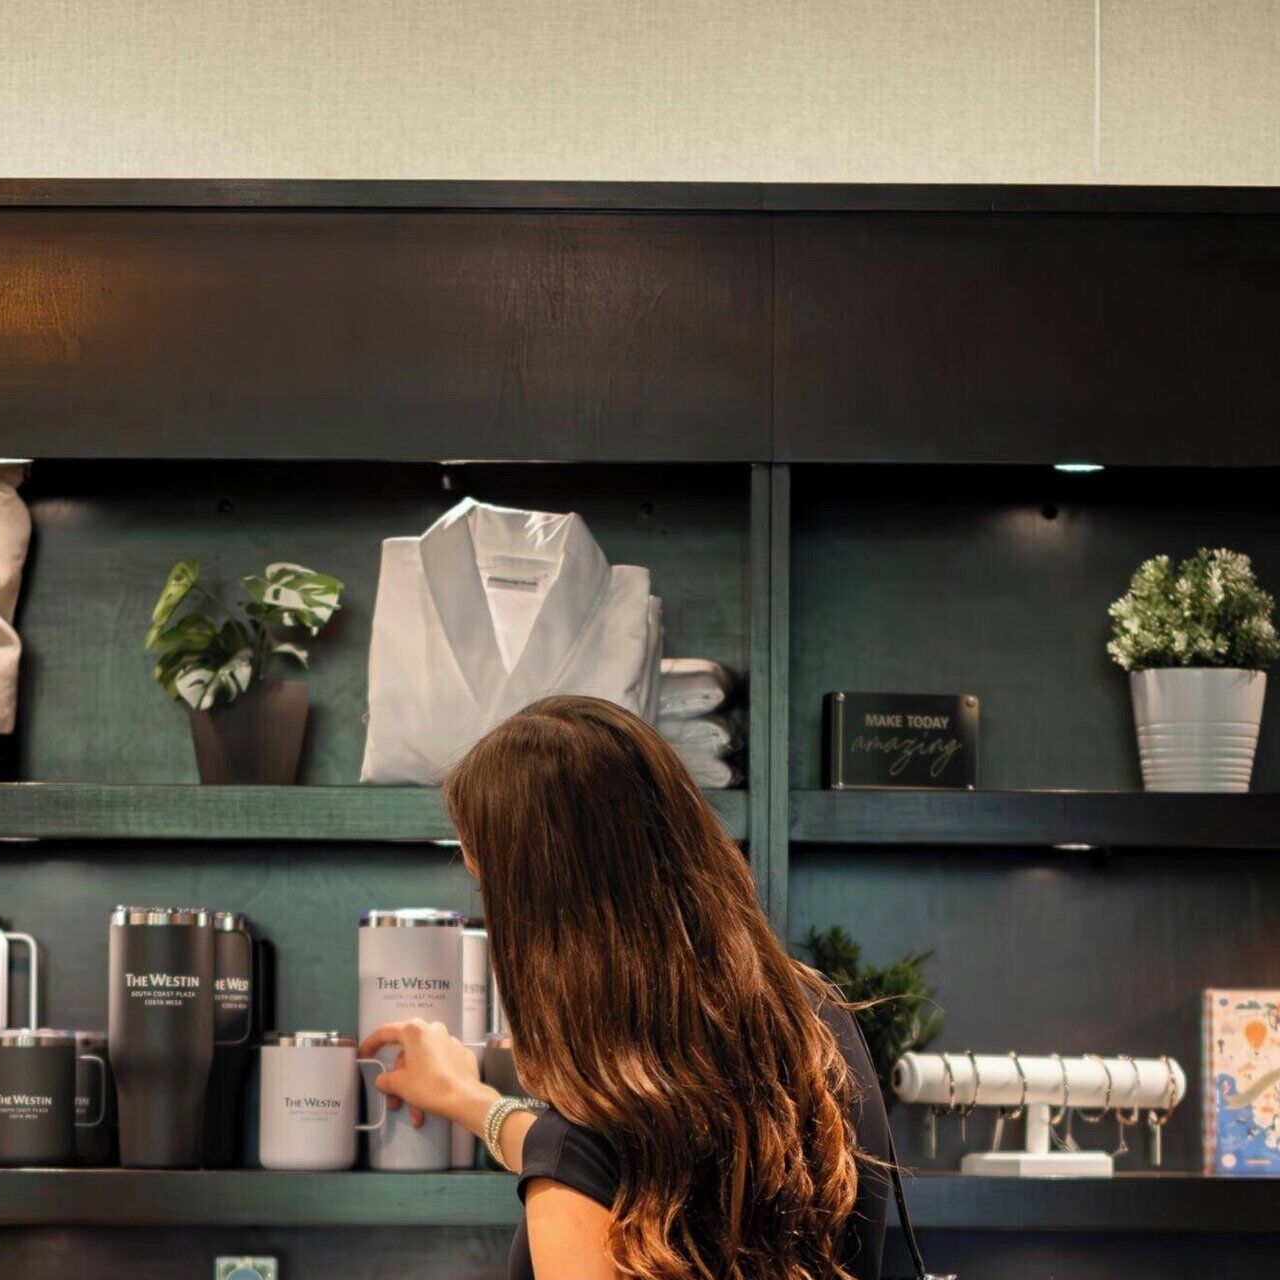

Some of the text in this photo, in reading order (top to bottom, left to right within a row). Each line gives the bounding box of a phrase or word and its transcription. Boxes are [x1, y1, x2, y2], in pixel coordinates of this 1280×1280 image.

[865, 714, 950, 729] MAKE TODAY
[850, 731, 962, 777] amazing
[125, 973, 200, 988] THE WESTIN
[377, 977, 451, 990] THE WESTIN
[176, 990, 196, 998] PLAZA
[13, 1094, 53, 1105] WESTIN
[284, 1097, 341, 1108] THE WESTIN
